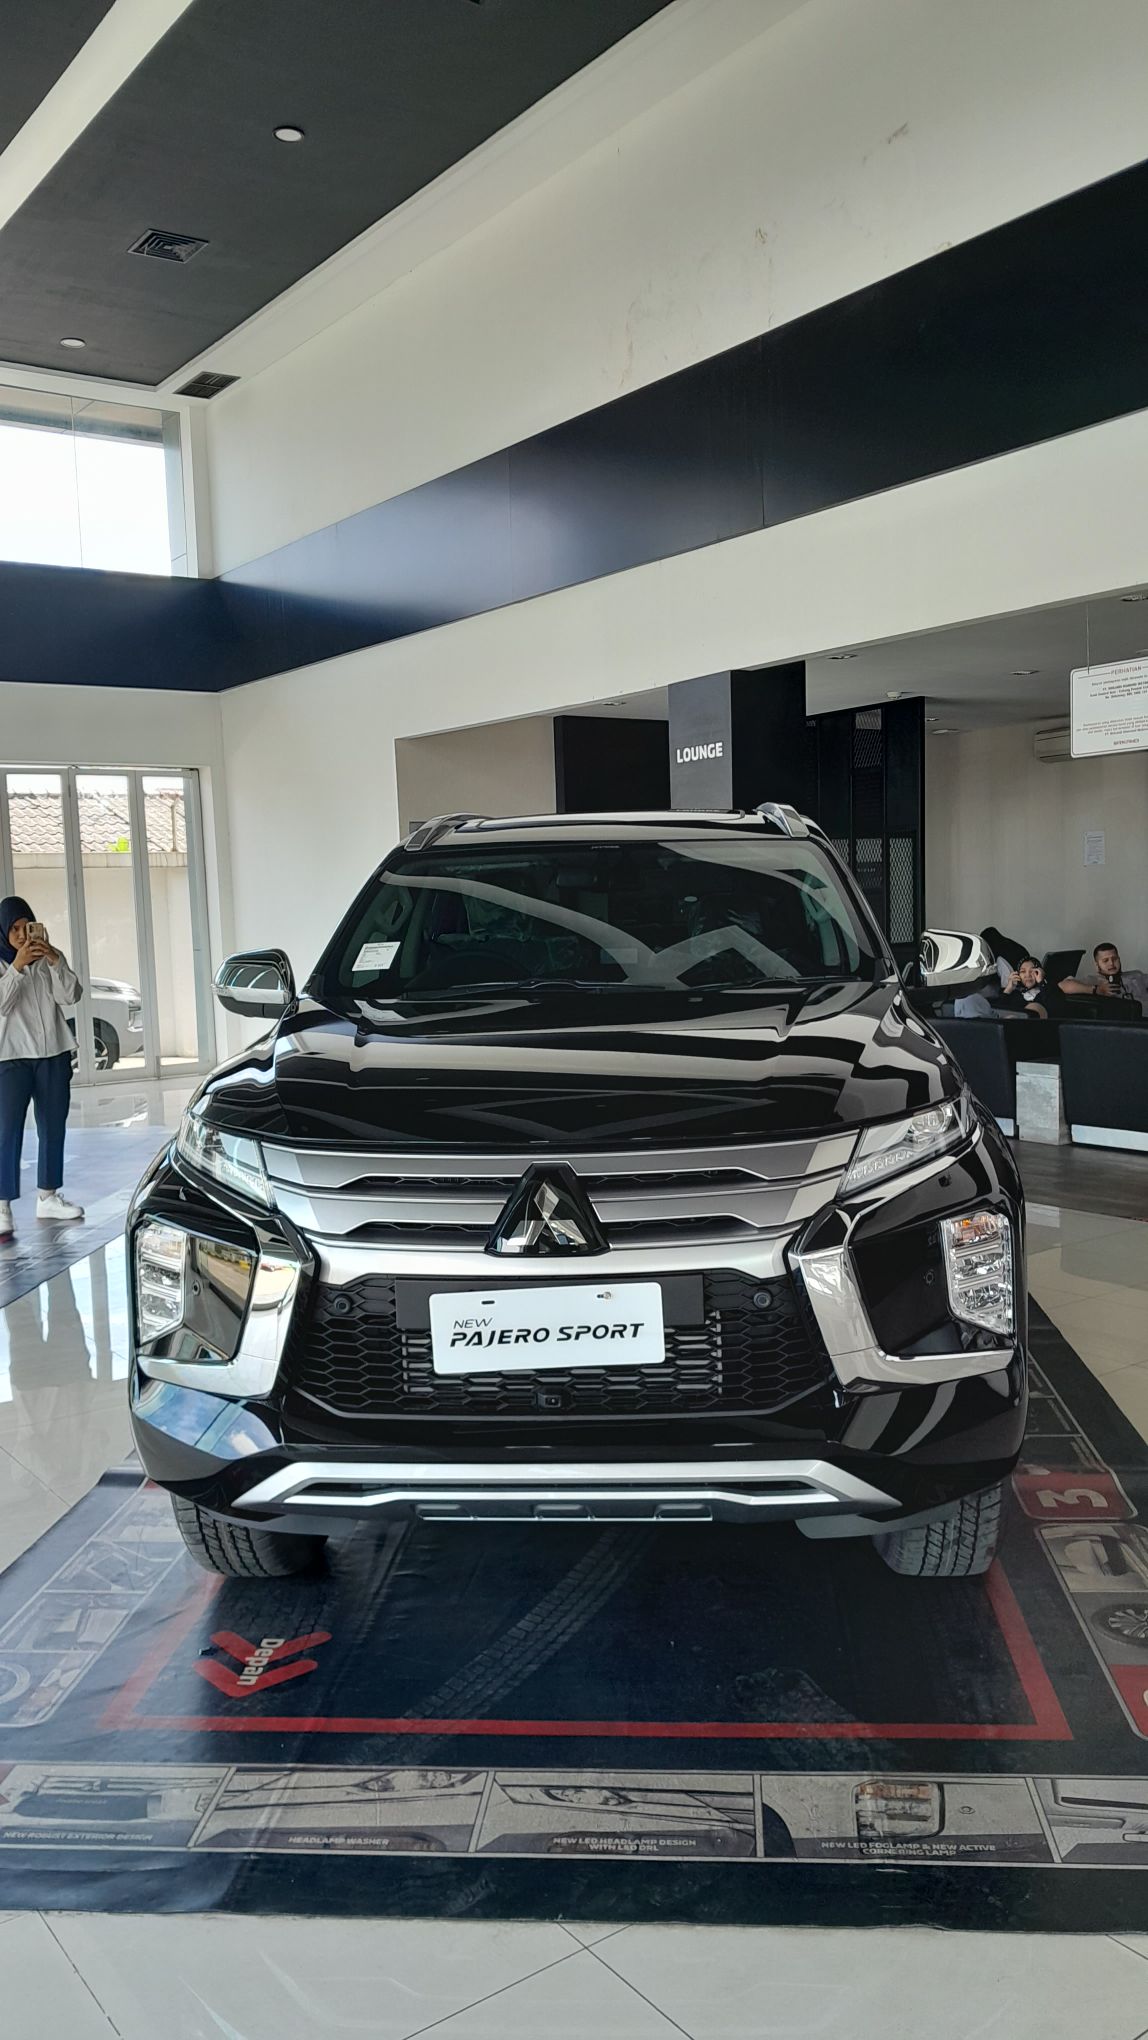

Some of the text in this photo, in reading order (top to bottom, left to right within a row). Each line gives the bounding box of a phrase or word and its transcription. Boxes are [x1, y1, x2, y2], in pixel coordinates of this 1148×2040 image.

[676, 742, 723, 763] LOUNGE
[453, 1317, 493, 1329] NEW
[450, 1323, 645, 1348] PAJERO SPORT
[236, 1638, 286, 1686] Depan
[288, 1835, 390, 1846] HEADLAMP WASHER
[552, 1837, 577, 1845] NEW
[578, 1837, 598, 1845] LED
[599, 1837, 657, 1846] HEADLAMP
[589, 1843, 617, 1851] WITH
[638, 1844, 659, 1852] DRL
[821, 1841, 846, 1849] NEW
[847, 1841, 868, 1849] LED
[869, 1842, 921, 1850] FOGLAMP
[932, 1843, 955, 1851] NEW
[959, 1844, 997, 1852] ACTIVE
[862, 1848, 957, 1857] CORNERING LAMP
